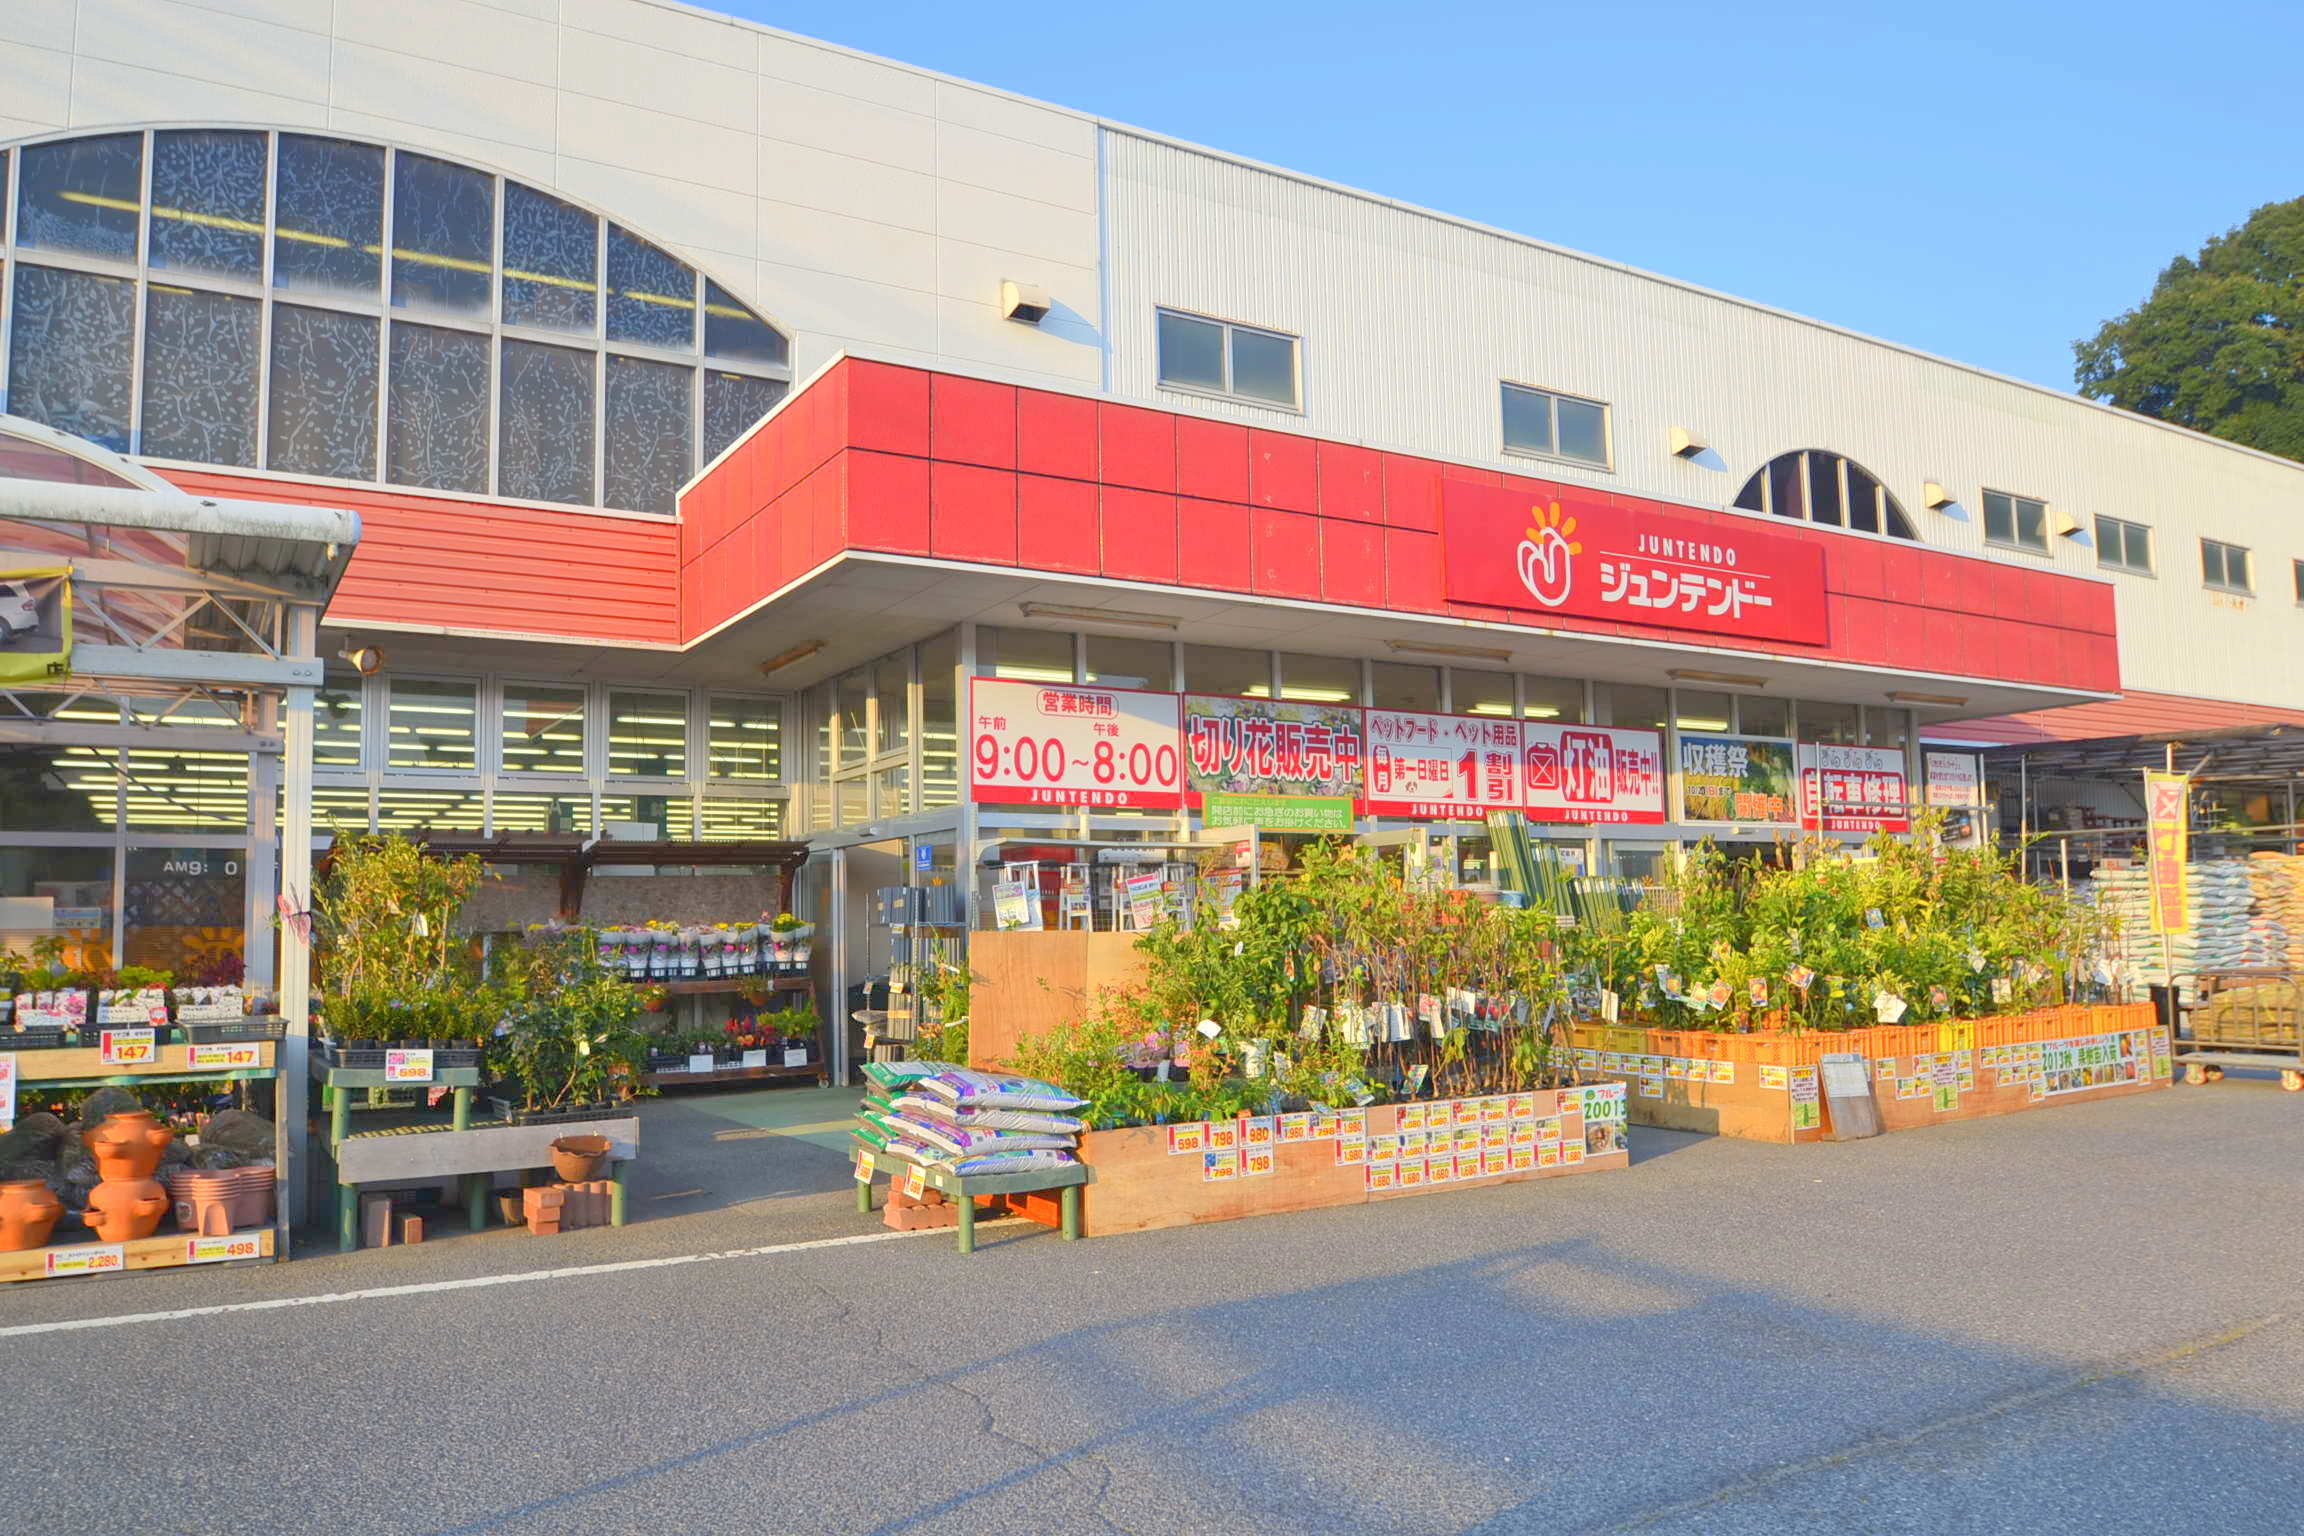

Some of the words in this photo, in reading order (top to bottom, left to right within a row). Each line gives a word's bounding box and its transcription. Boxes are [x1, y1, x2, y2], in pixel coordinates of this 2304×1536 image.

[1638, 534, 1736, 567] JUNTENDO
[1600, 562, 1773, 619] ジュンテンドー
[1043, 691, 1112, 715] 営業時間
[978, 716, 1006, 731] 午前
[1093, 723, 1120, 737] 午後
[1189, 714, 1360, 783] 切り花販売中
[1375, 746, 1388, 790] 毎月
[1563, 735, 1610, 800] 灯油
[1683, 742, 1749, 778] 収穫祭
[1394, 757, 1449, 781] 第一日曜日
[1030, 789, 1129, 805] JUNTENDO
[1806, 770, 1903, 815] 自転車修理
[1411, 804, 1484, 816] JUNTENDO
[1565, 809, 1629, 821] JUNTENDO
[1832, 820, 1880, 830] JUNTENDO
[117, 1046, 149, 1060] 147
[226, 1051, 254, 1064] 147
[1213, 1131, 1233, 1147] 798
[1249, 1127, 1270, 1143] 980
[1250, 1155, 1269, 1172] 798
[1214, 1167, 1233, 1178] 798
[227, 1243, 255, 1256] 498
